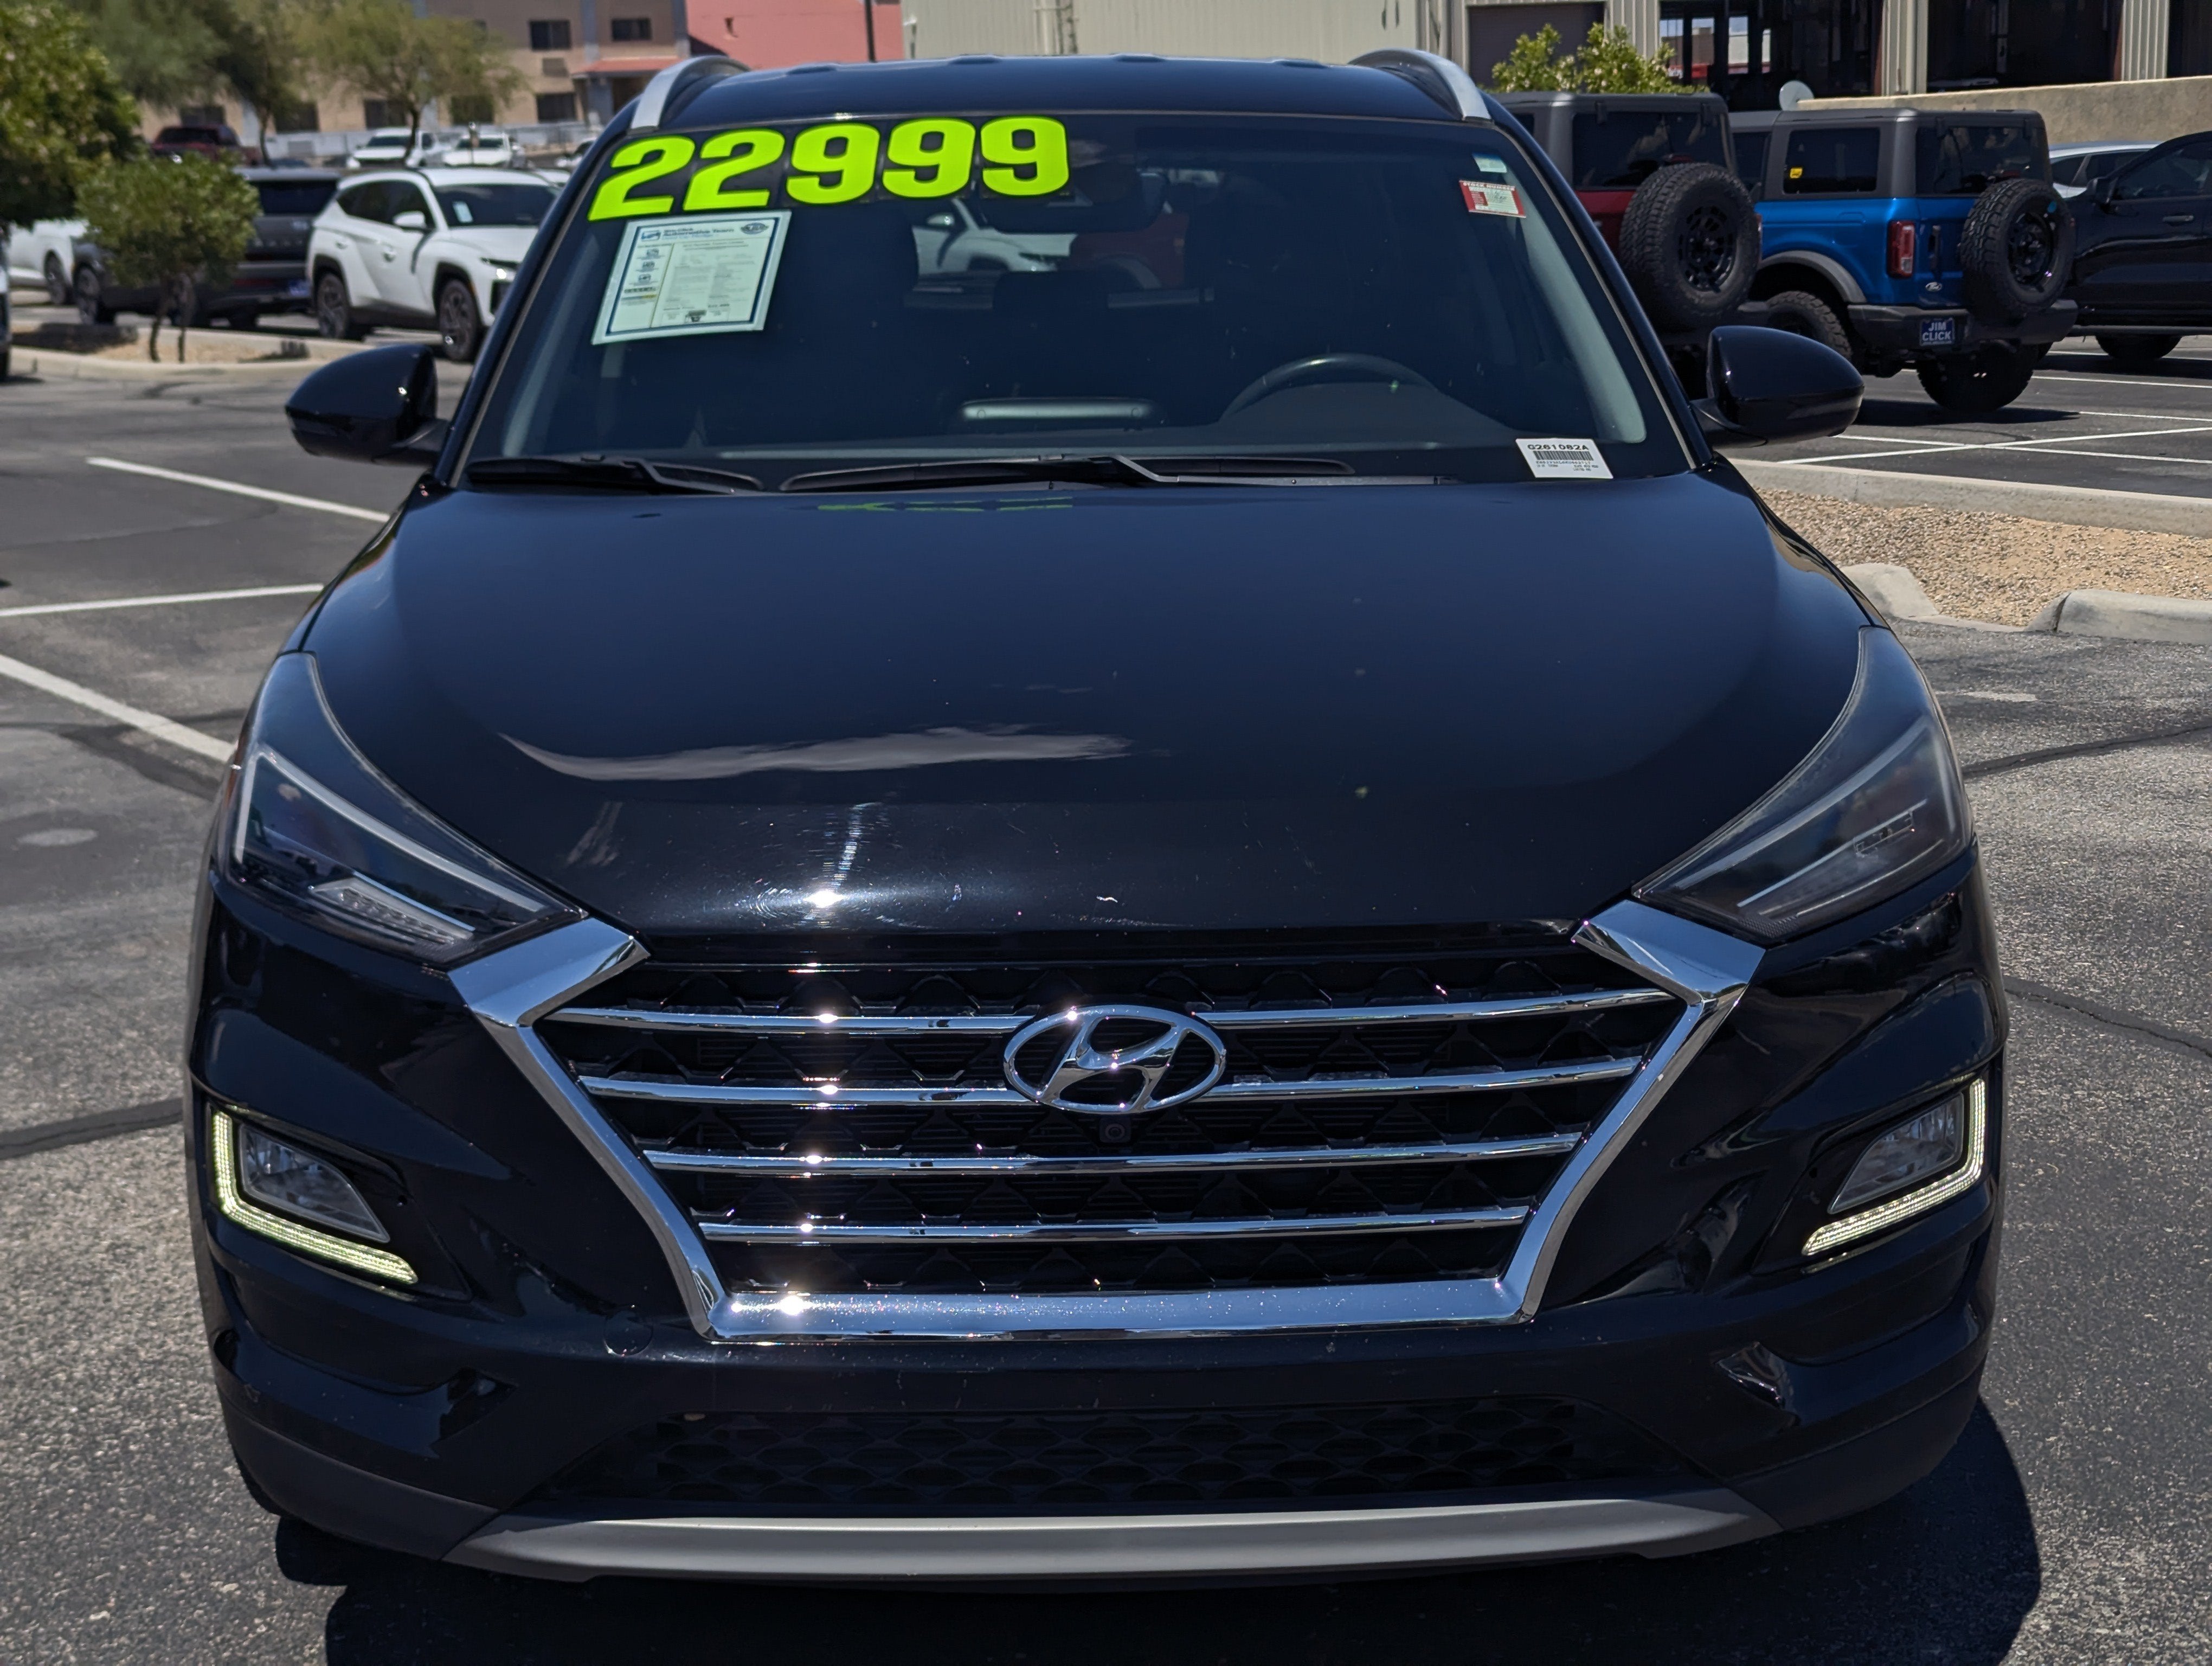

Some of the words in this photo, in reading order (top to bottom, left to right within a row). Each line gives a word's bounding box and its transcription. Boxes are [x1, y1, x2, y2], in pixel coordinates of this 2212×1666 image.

[588, 117, 1069, 221] 22999
[1928, 321, 1946, 331] JIM
[1922, 331, 1951, 341] CLICK
